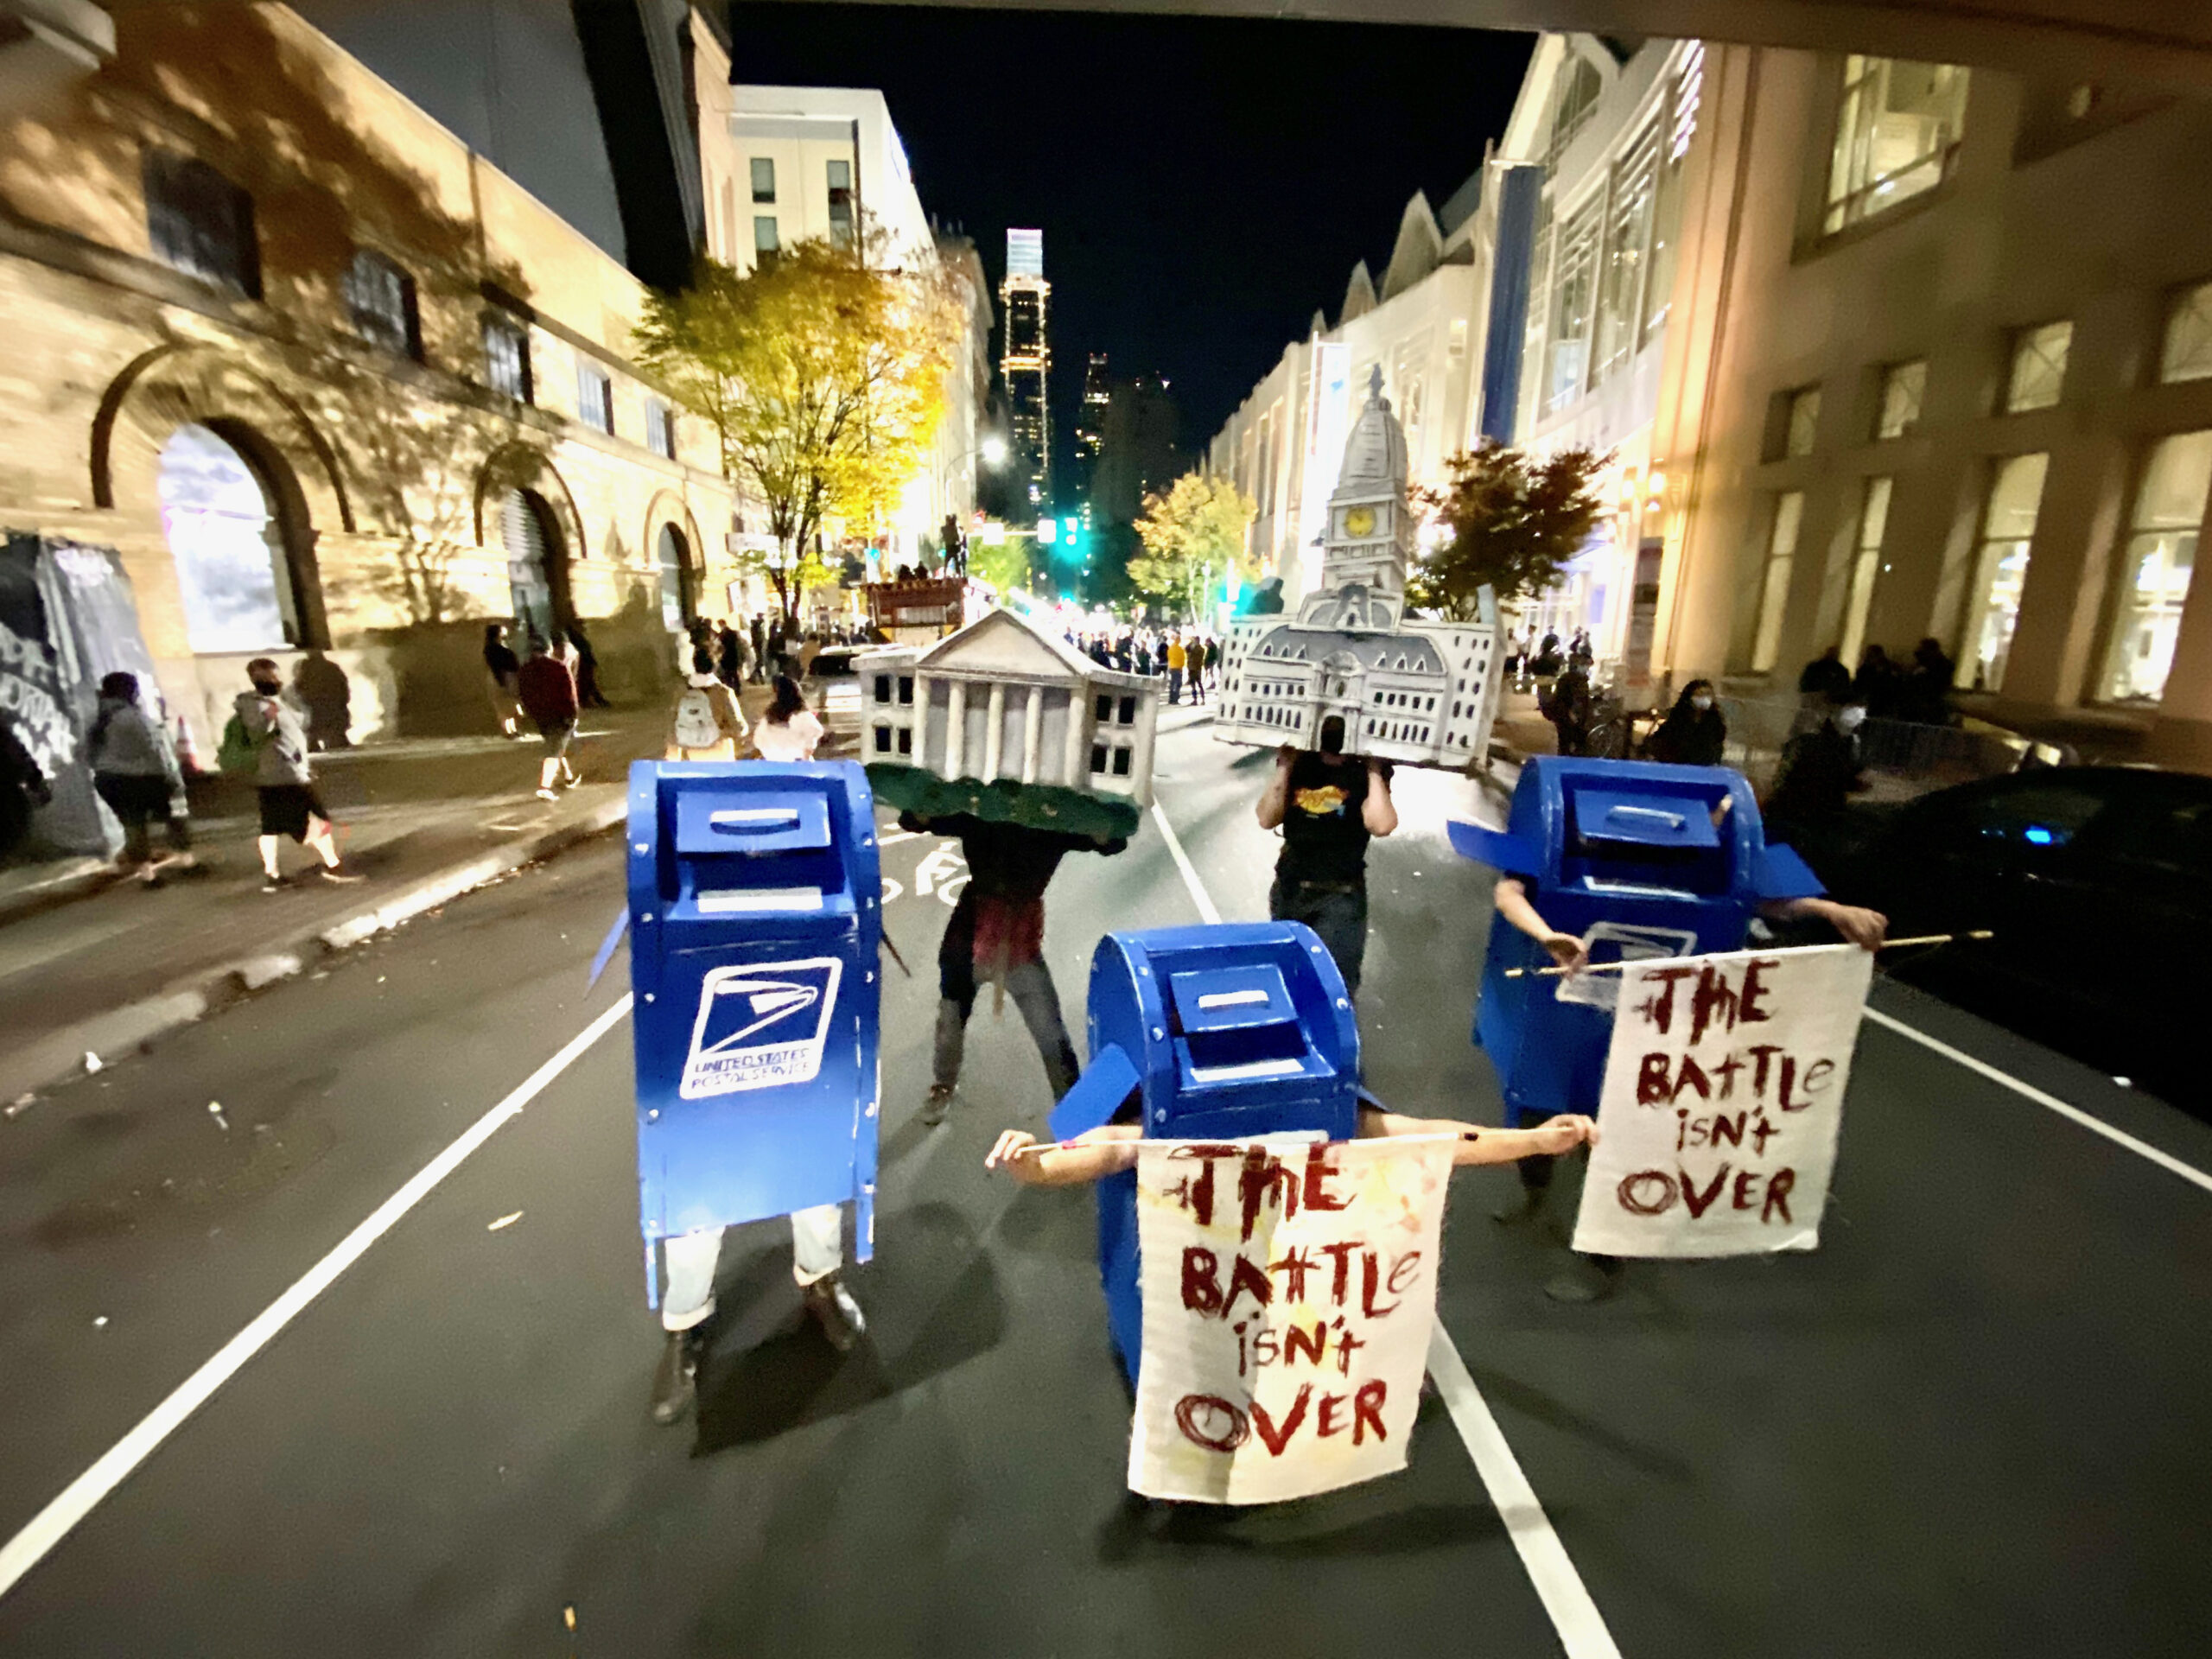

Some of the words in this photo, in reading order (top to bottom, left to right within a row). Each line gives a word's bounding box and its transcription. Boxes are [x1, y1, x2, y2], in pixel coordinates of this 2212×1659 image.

[691, 1071, 747, 1090] POSTAL
[753, 1061, 810, 1080] SERVICE
[695, 1055, 753, 1073] UNITED
[757, 1047, 810, 1064] STATES
[1617, 1161, 1796, 1225] OVER
[1174, 1379, 1388, 1458] OVER
